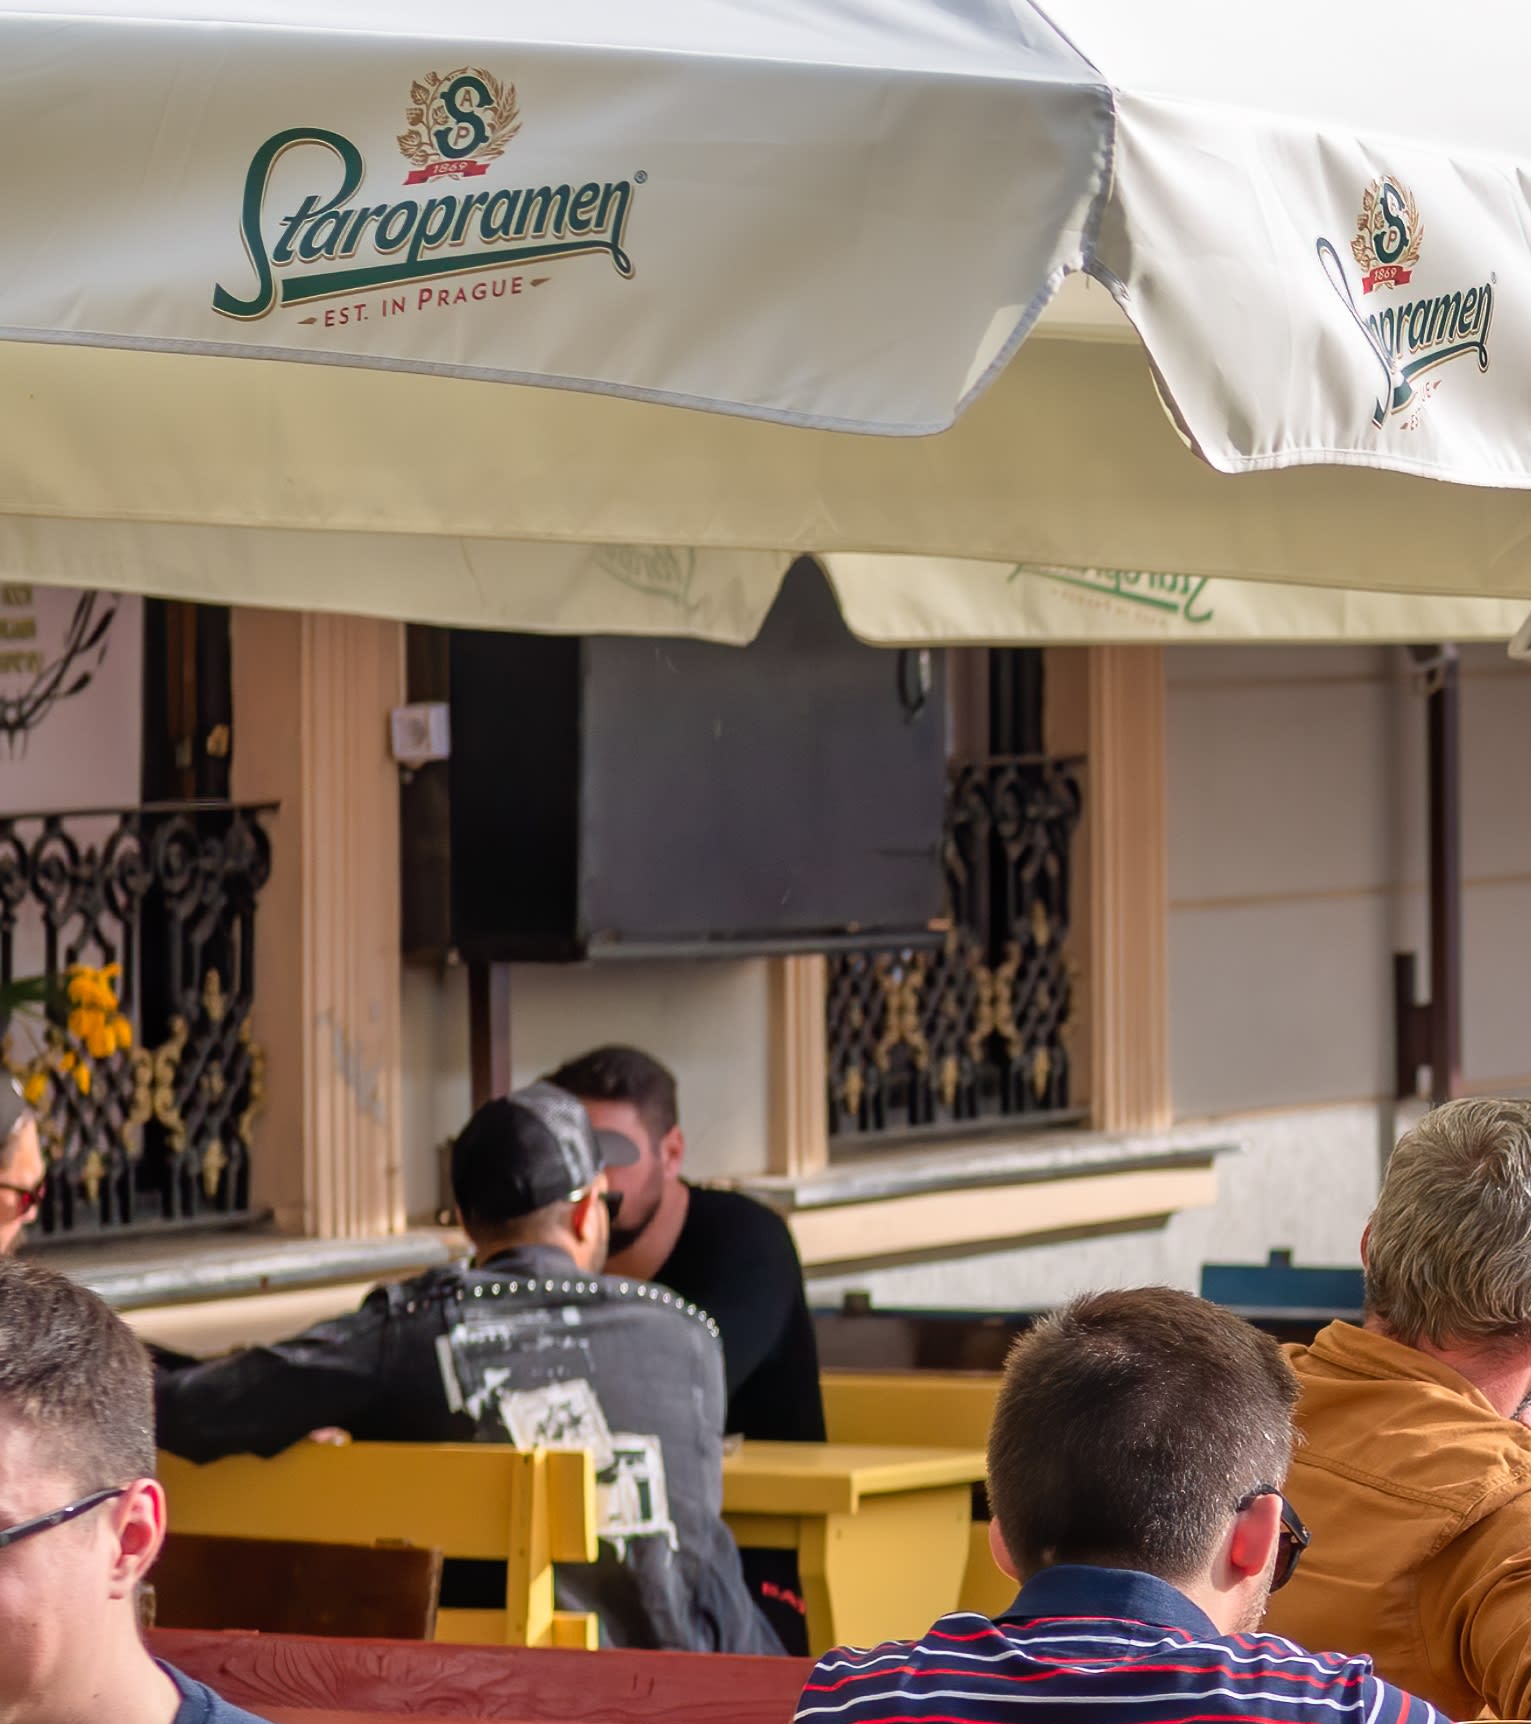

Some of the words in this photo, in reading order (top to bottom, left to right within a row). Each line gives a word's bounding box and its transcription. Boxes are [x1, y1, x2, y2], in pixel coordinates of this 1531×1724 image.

[432, 161, 469, 174] 1869
[212, 127, 634, 319] Staropramen
[1373, 267, 1398, 282] 1869
[323, 303, 369, 328] EST.
[381, 296, 406, 317] IN
[417, 276, 524, 311] PRAGUE
